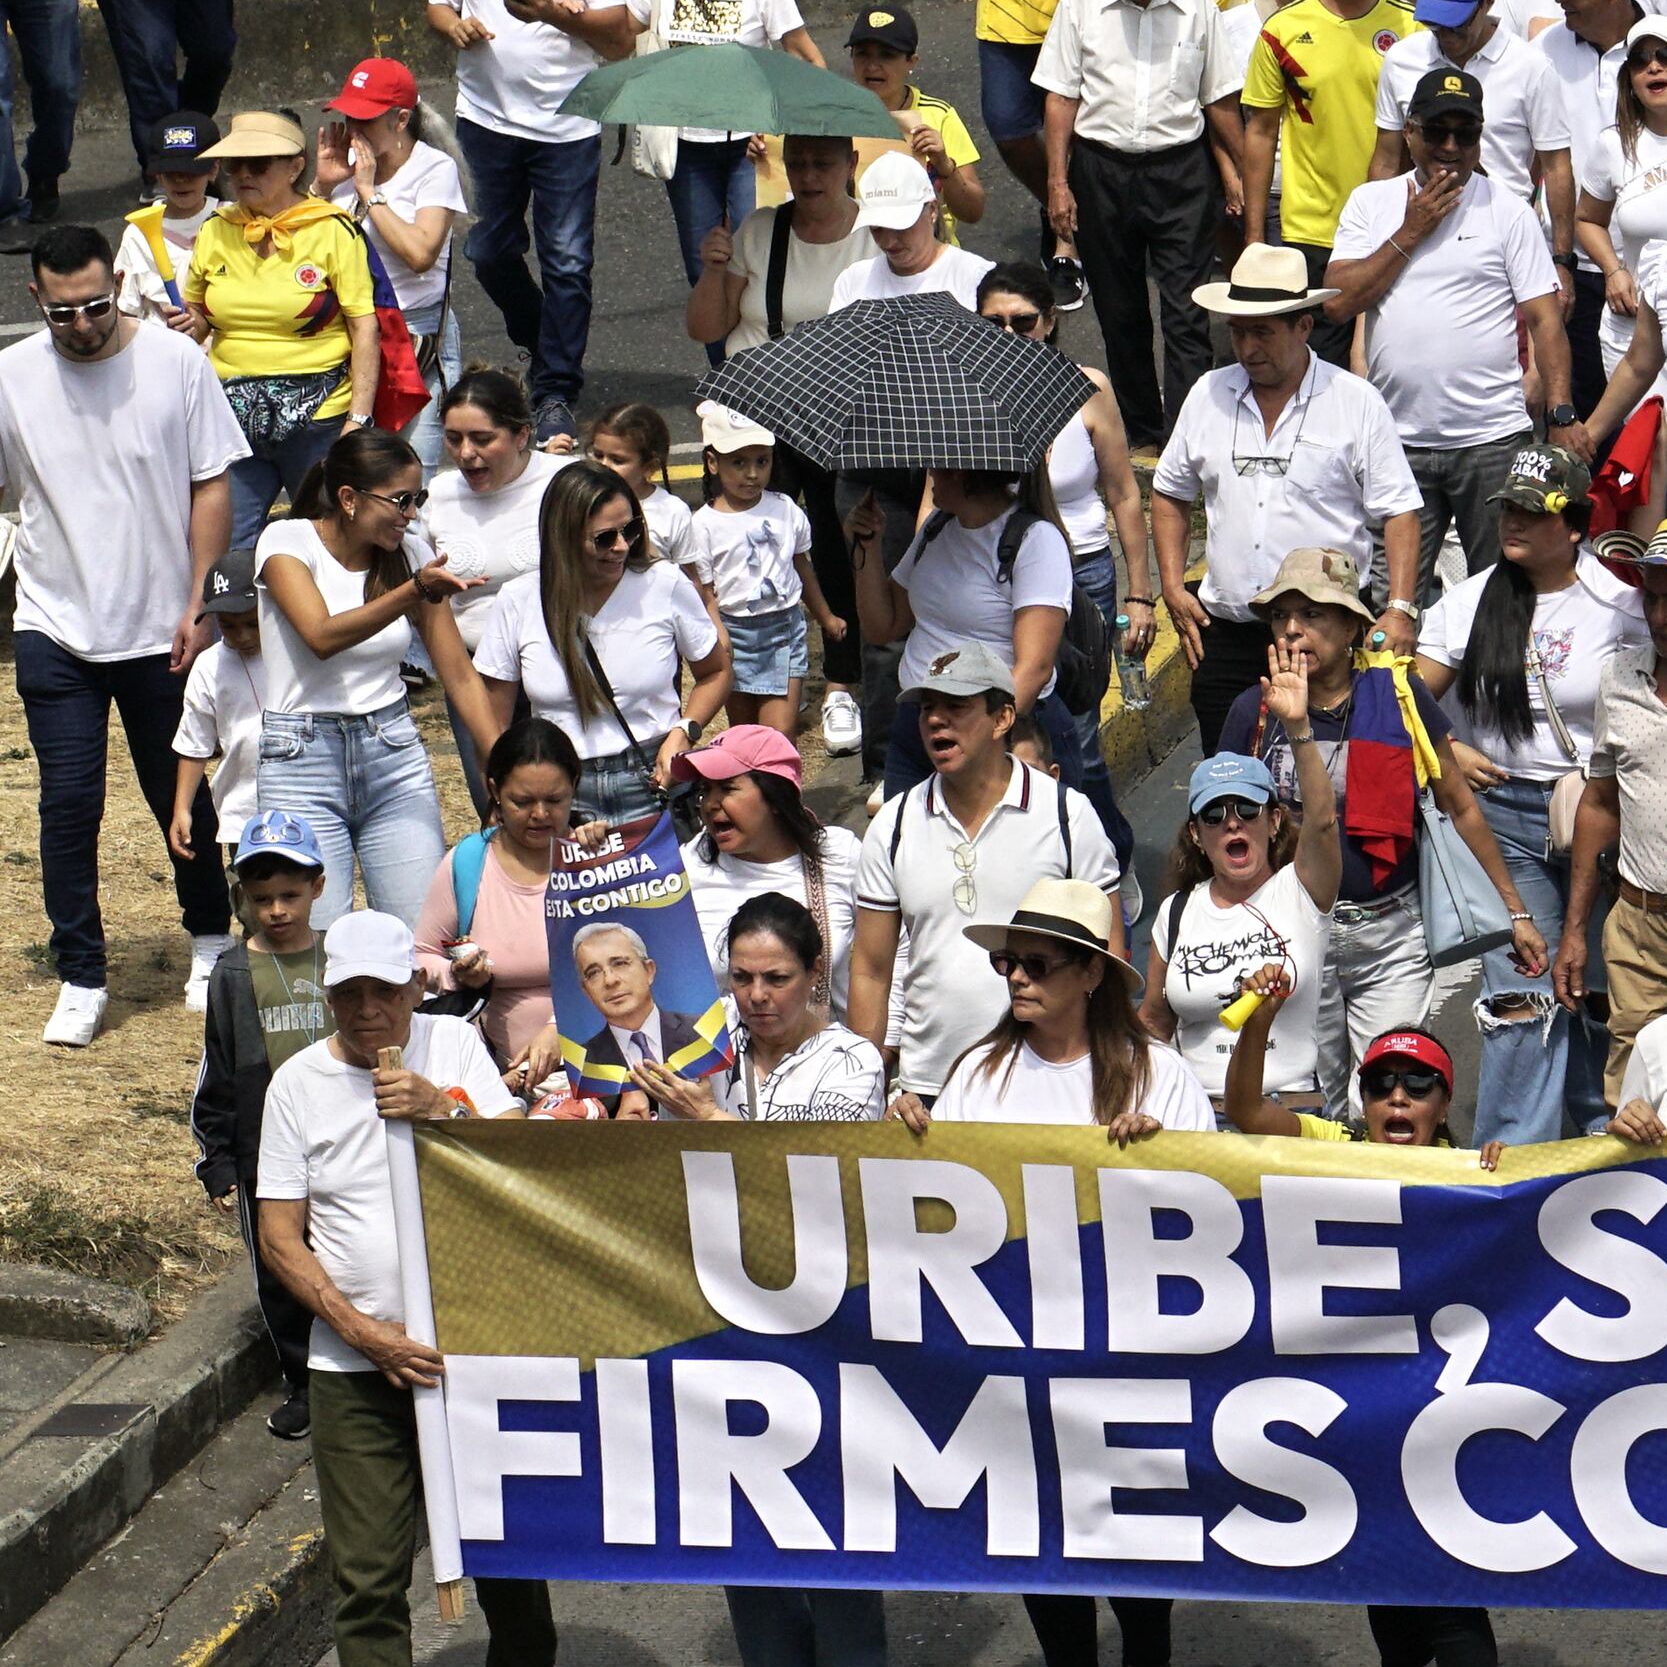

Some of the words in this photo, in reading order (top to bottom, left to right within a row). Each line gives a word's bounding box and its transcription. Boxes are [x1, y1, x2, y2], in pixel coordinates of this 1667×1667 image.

[865, 189, 898, 199] miami
[1511, 464, 1547, 484] CABAL
[1514, 450, 1553, 472] 100%
[213, 570, 229, 595] LA
[550, 854, 657, 892] COLOMBIA
[546, 896, 596, 920] ESTA
[600, 874, 684, 916] CONTIGO
[1193, 923, 1277, 962] CHEMICAL
[681, 1151, 1492, 1397] URIBE,
[445, 1354, 1359, 1567] FIRMES
